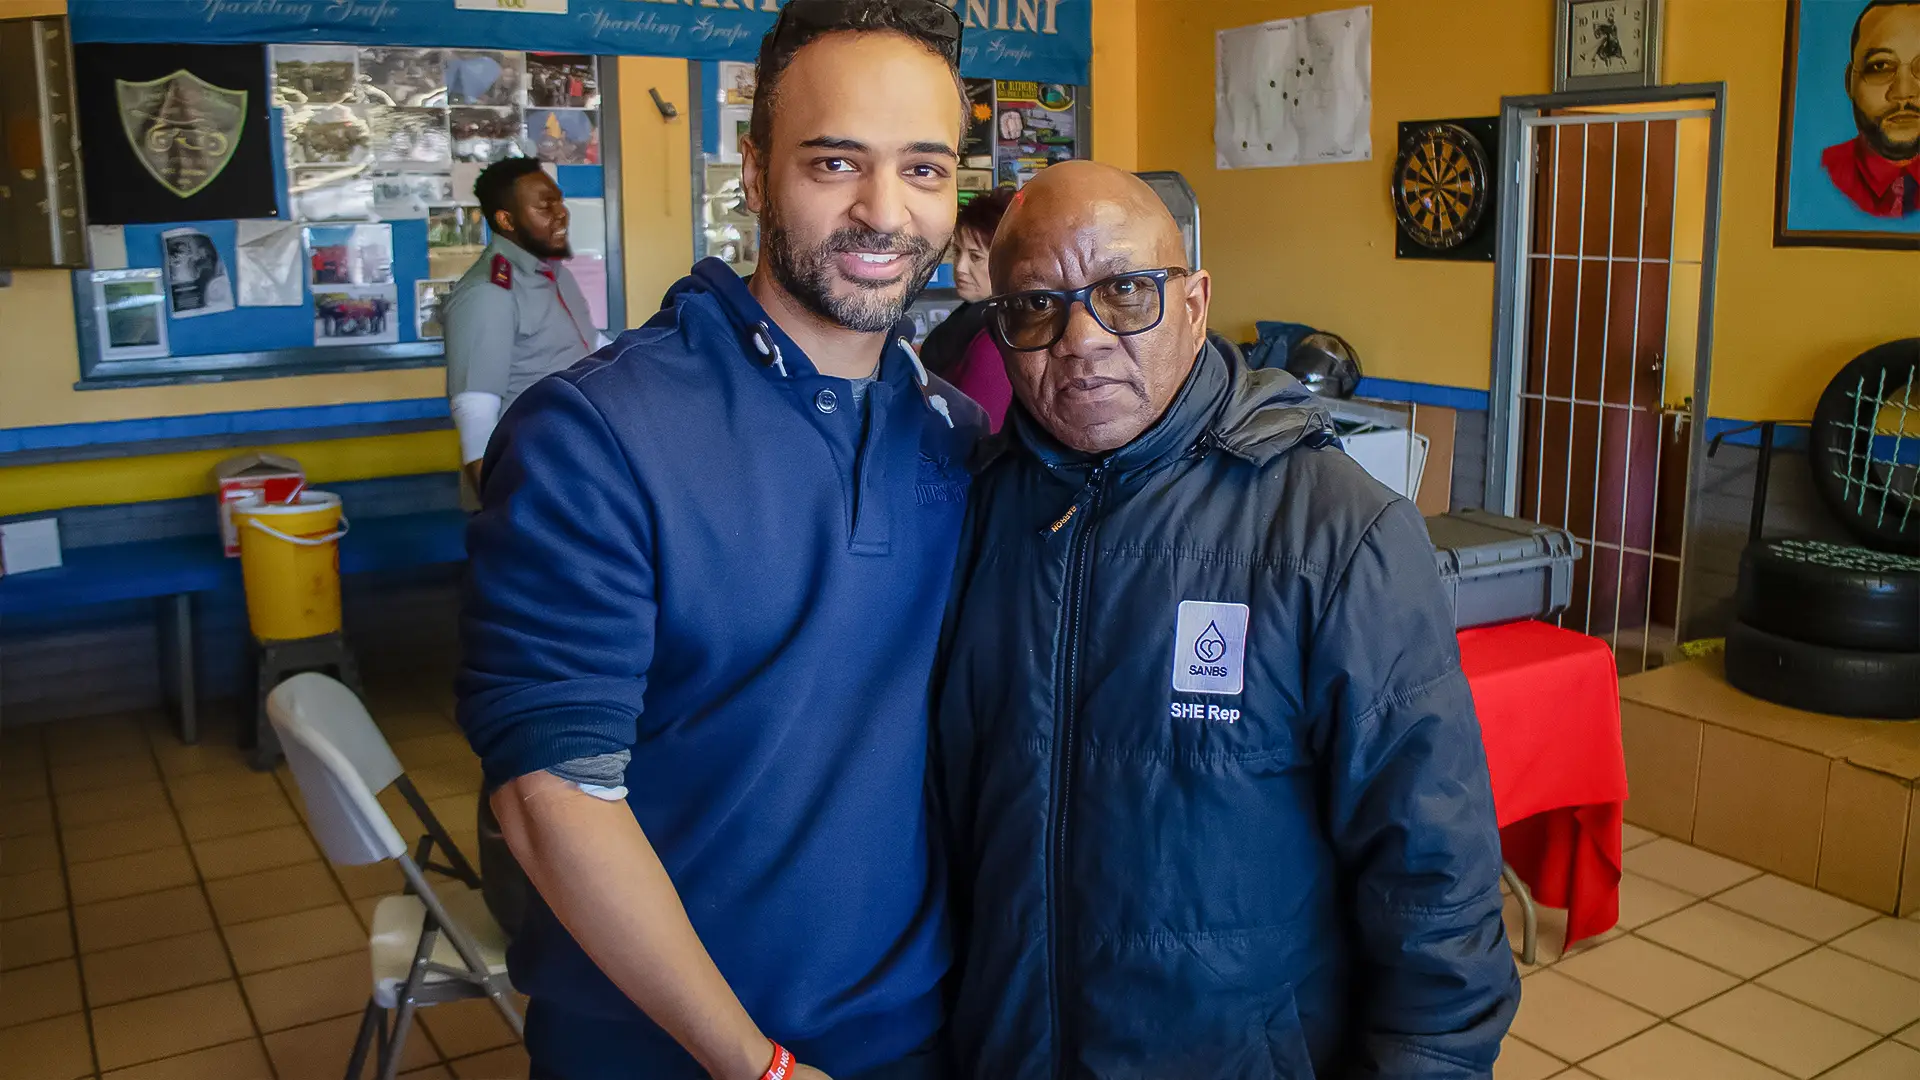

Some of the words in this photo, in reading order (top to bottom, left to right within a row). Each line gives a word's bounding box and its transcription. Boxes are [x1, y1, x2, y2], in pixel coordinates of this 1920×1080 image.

[577, 6, 682, 38] Sparkling
[690, 13, 752, 47] Grape
[951, 0, 1058, 34] NINI
[1188, 664, 1228, 677] SANBS
[1170, 702, 1205, 719] SHE
[1207, 704, 1241, 724] Rep
